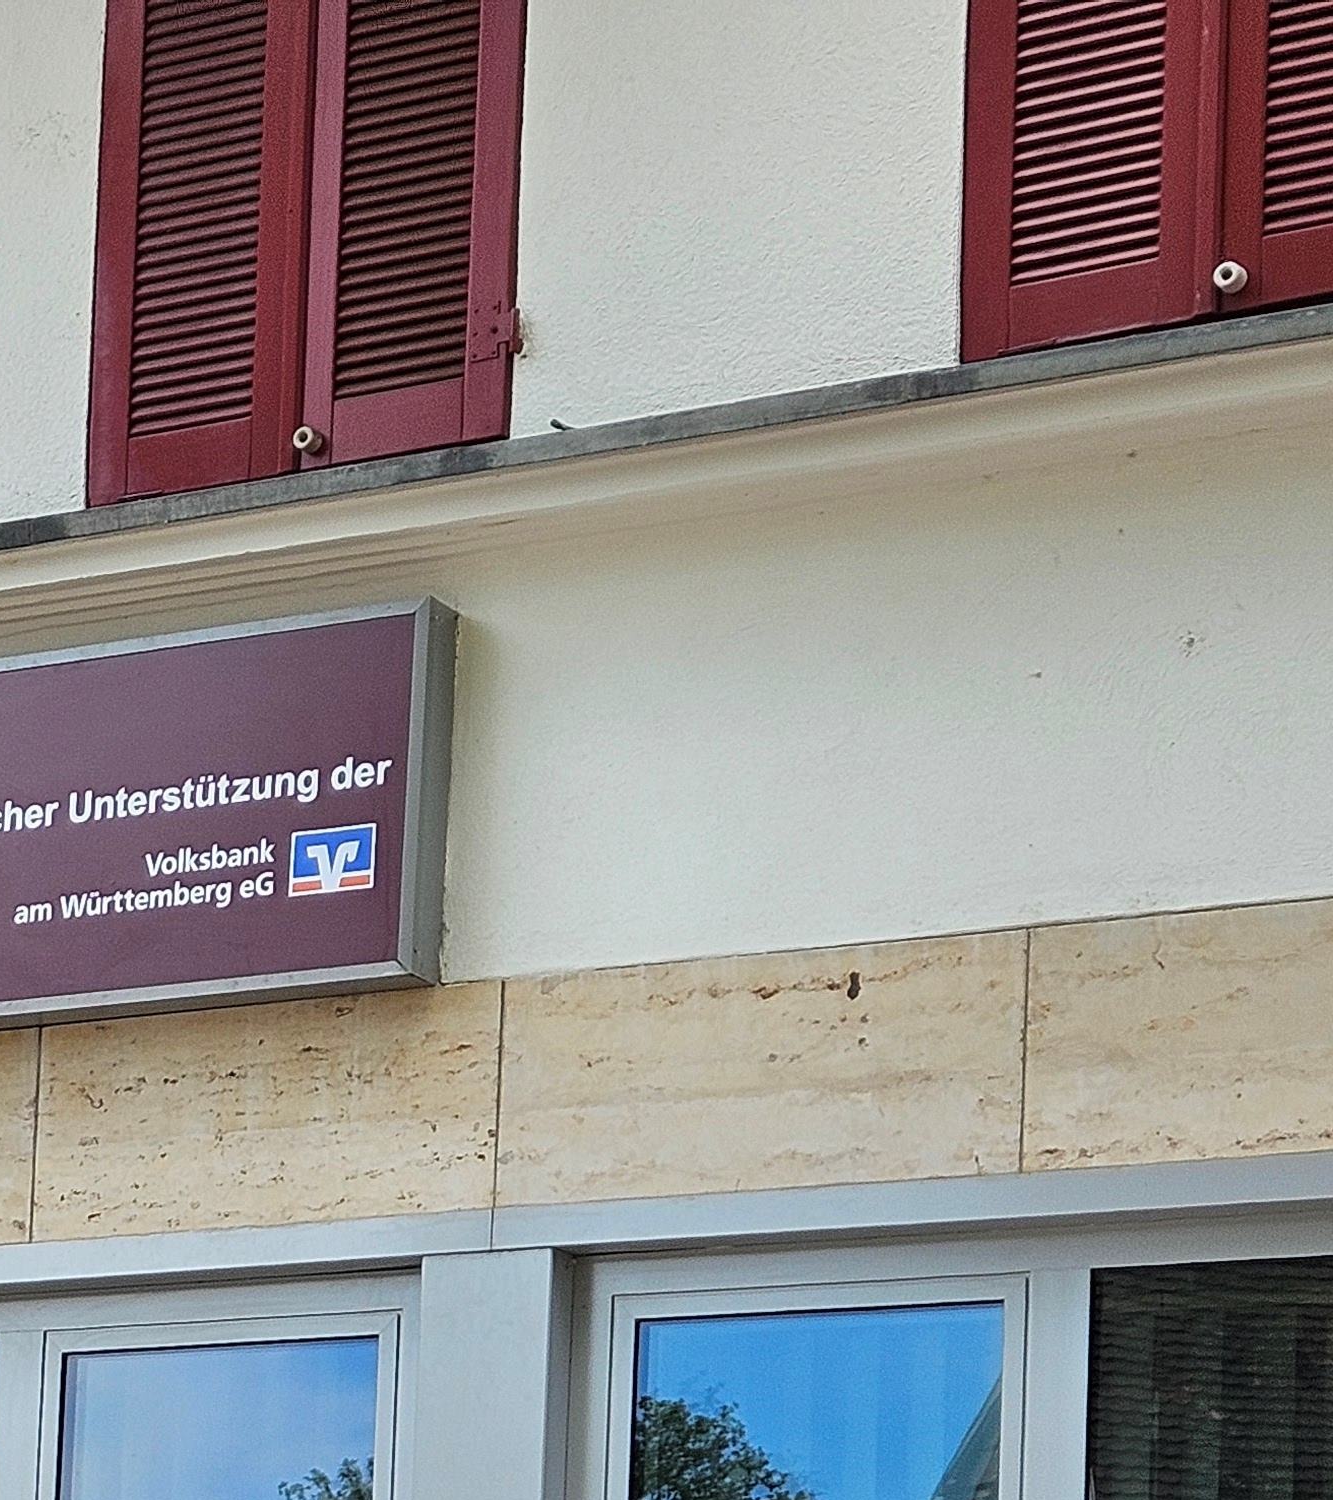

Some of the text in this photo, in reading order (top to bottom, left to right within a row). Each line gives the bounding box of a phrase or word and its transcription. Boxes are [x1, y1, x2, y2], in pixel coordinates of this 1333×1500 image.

[68, 768, 320, 826] Unterstützung
[330, 755, 393, 791] der
[144, 838, 276, 878] Volksbank
[13, 871, 276, 925] am Württemberg eG
